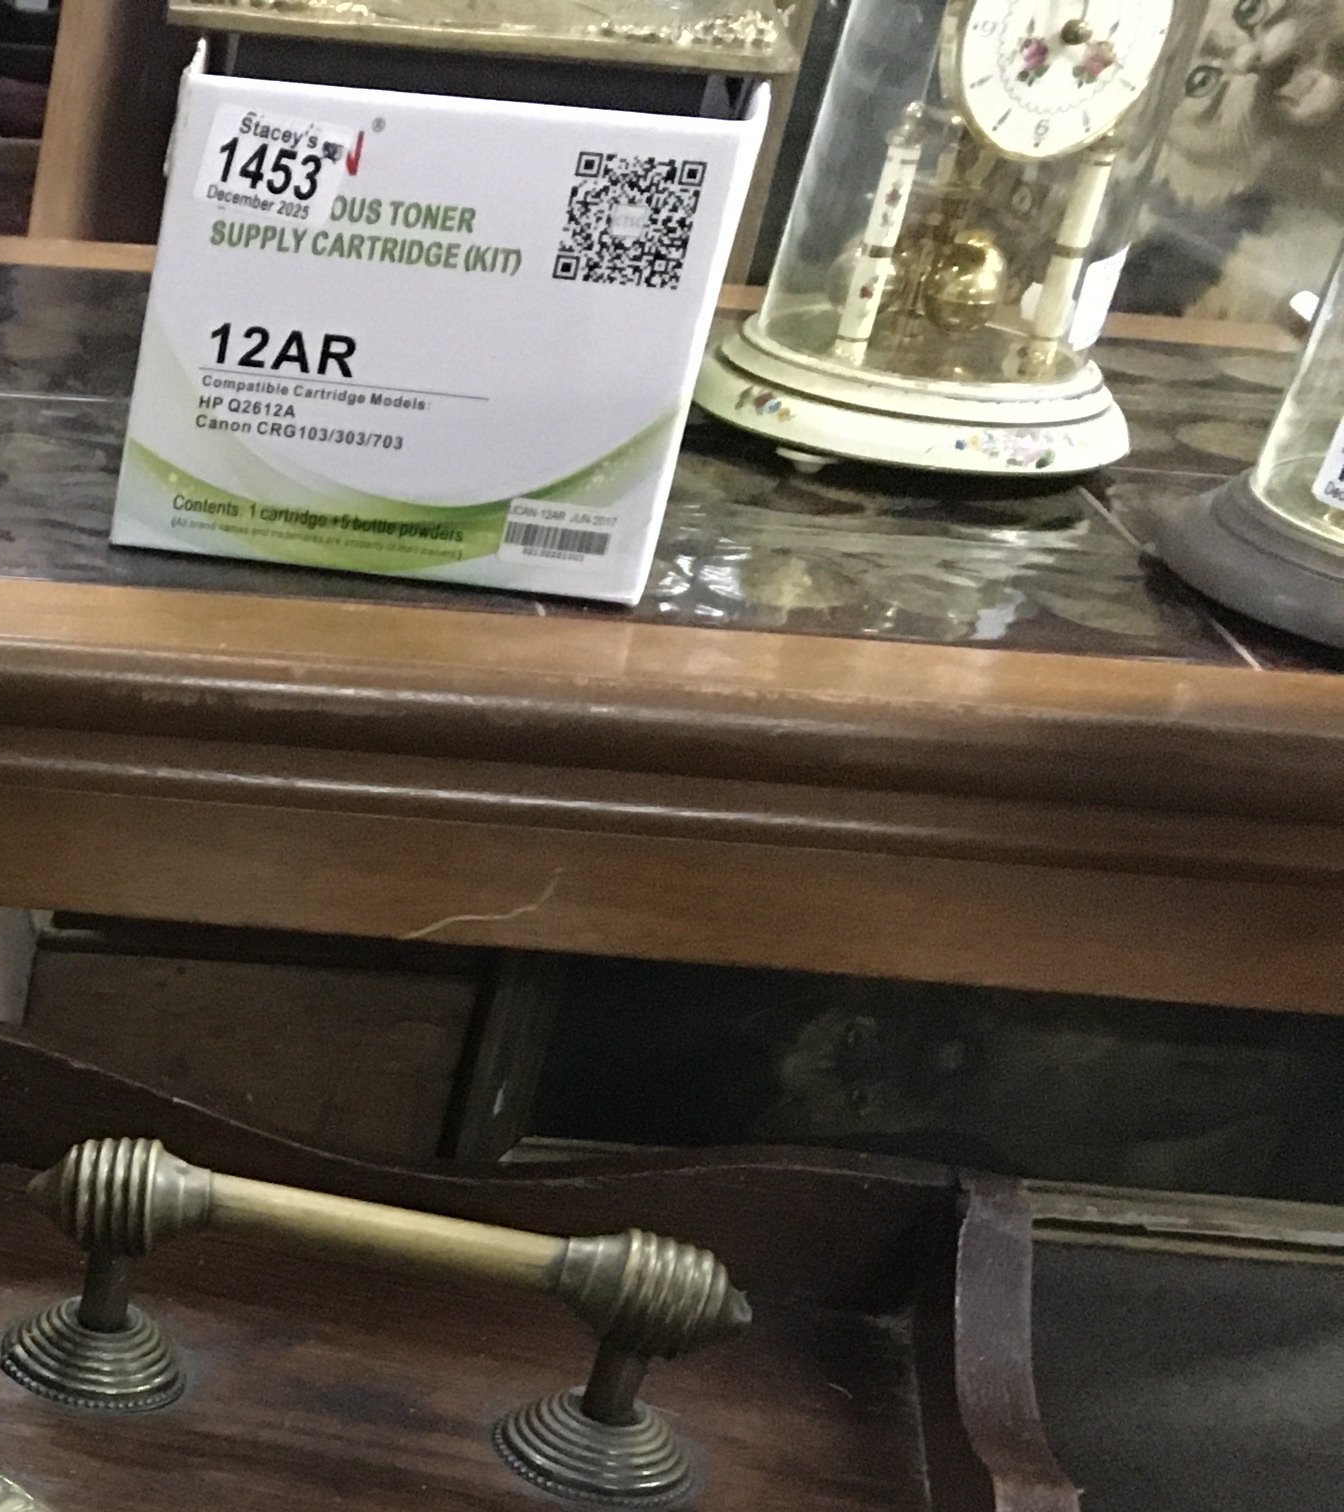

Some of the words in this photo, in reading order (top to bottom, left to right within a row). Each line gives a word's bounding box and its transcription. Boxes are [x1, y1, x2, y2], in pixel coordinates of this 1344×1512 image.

[239, 115, 318, 149] Stacey's
[1034, 119, 1050, 136] 6
[219, 137, 322, 200] 1453
[207, 184, 276, 211] December
[277, 200, 310, 220] 2025
[389, 201, 476, 234] TONER
[209, 220, 308, 255] SUPPLY
[311, 230, 462, 270] CARTRIDGE
[463, 244, 523, 277] (KIT)
[210, 322, 357, 378] 12AR
[198, 395, 224, 410] HP
[228, 398, 296, 418] Q2612A
[202, 374, 289, 396] Compatible
[293, 384, 366, 406] Cartridge
[195, 414, 252, 433] Canon
[257, 421, 404, 451] CRG103/303/703
[250, 502, 257, 518] 1
[260, 506, 328, 529] cartridge
[399, 521, 465, 542] powders
